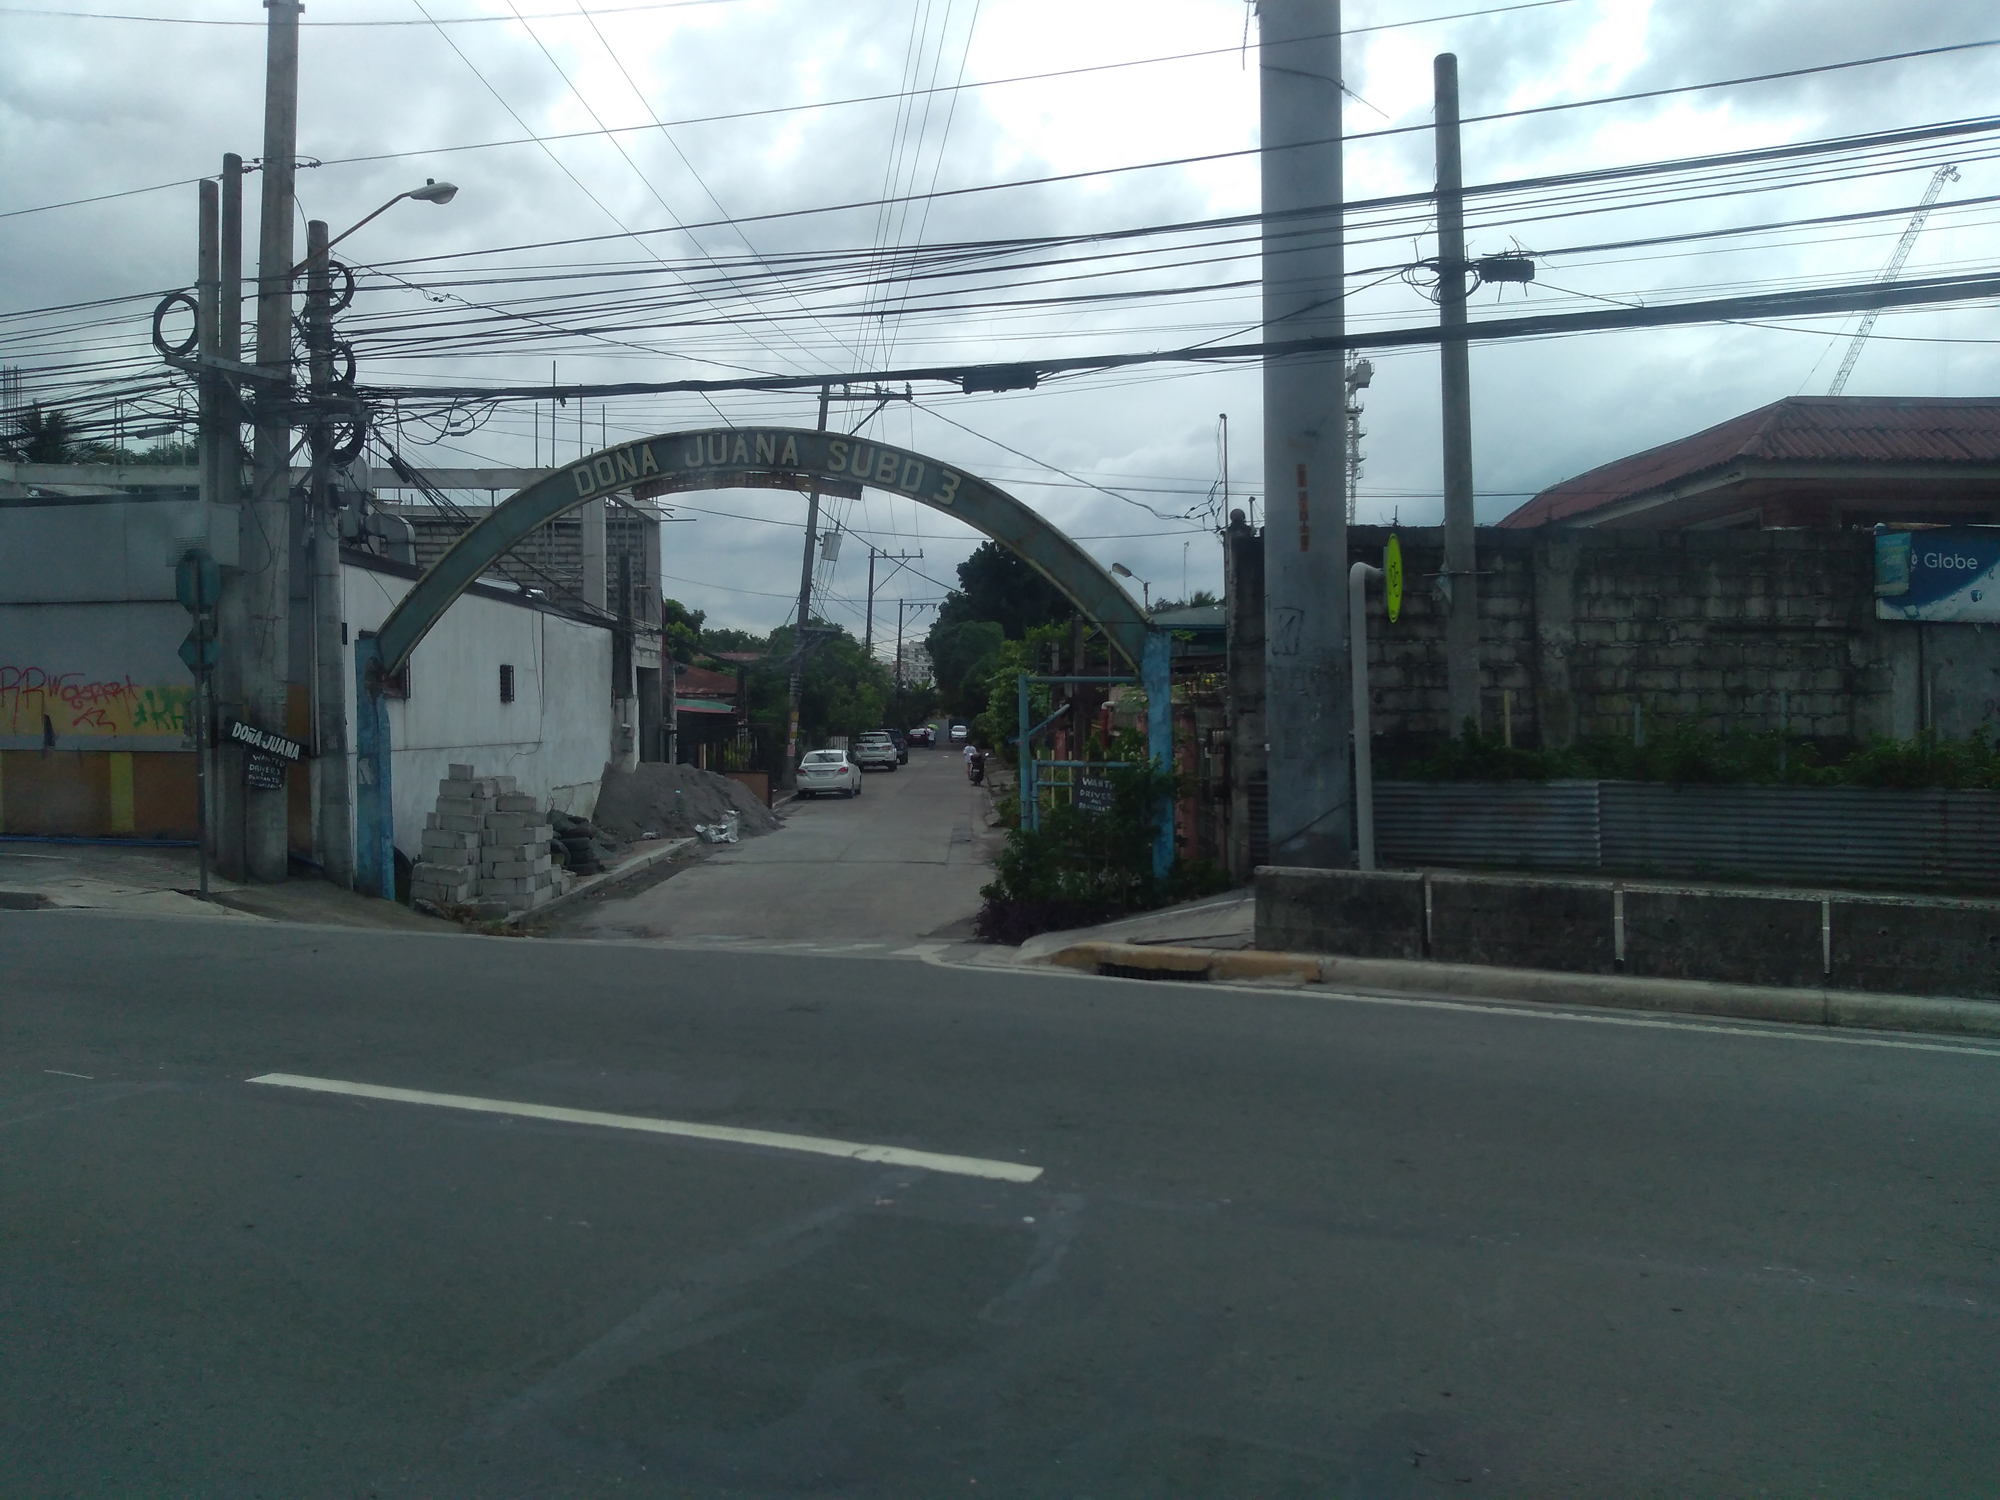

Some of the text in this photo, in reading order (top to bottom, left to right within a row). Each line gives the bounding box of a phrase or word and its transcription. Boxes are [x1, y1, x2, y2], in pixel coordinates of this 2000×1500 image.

[685, 433, 799, 467] JUANA
[827, 440, 926, 493] SUBD
[933, 469, 962, 506] 3
[1924, 552, 1978, 570] Globe
[231, 721, 300, 760] DOÑA JUANA
[249, 763, 281, 776] DRIVERS
[252, 754, 286, 768] WANTED
